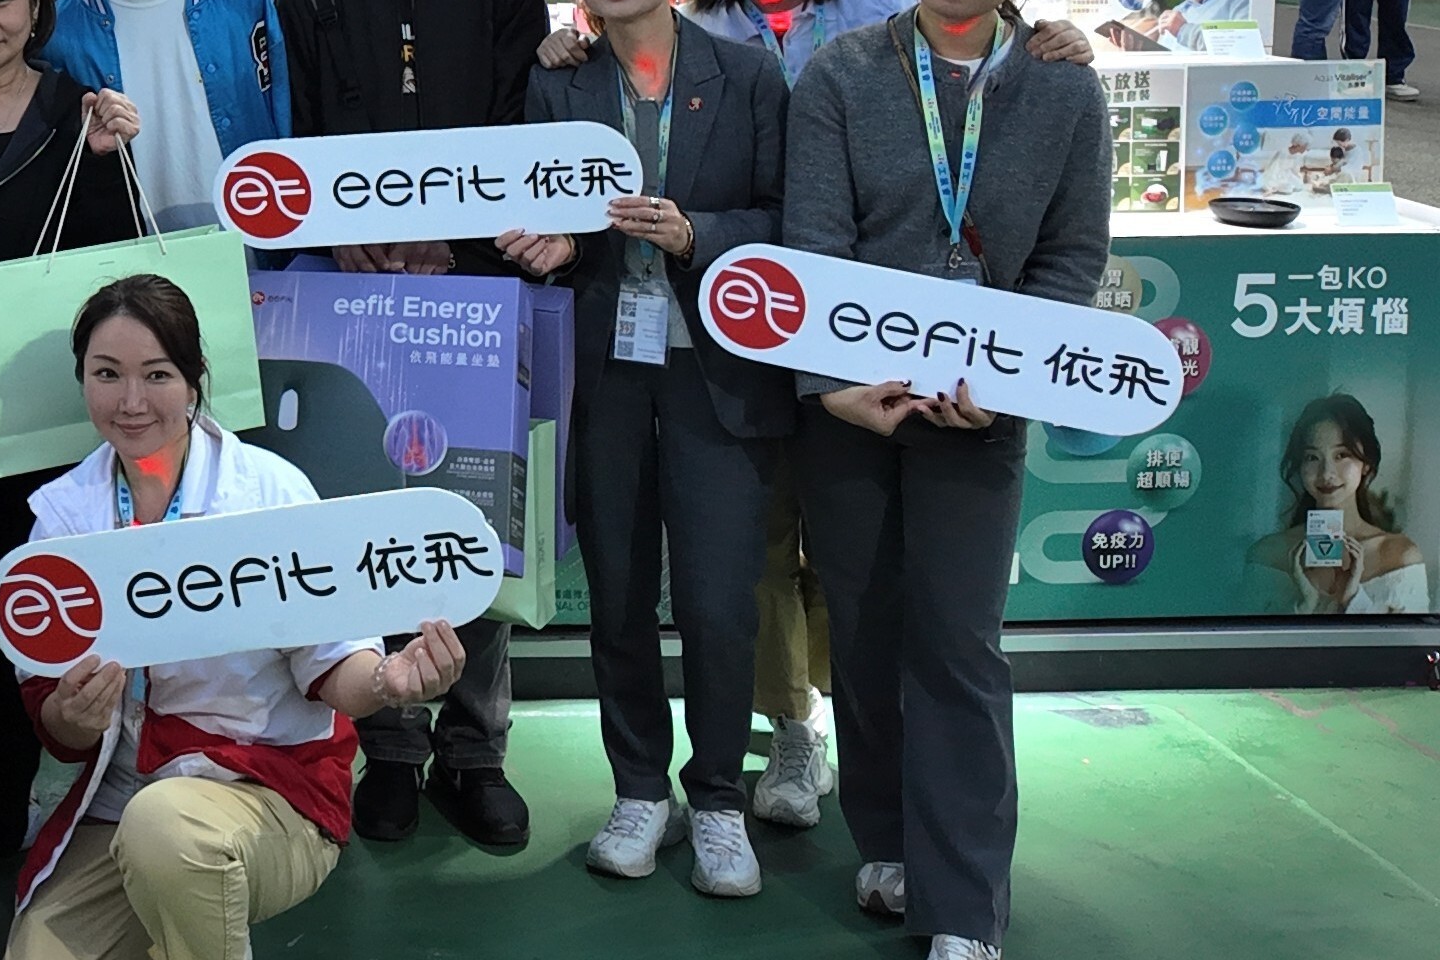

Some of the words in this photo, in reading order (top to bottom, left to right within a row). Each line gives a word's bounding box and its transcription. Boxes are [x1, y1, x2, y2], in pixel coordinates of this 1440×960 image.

[333, 164, 506, 209] eefit
[523, 158, 634, 200] 依飛
[1288, 265, 1388, 290] 一包KO
[333, 295, 395, 318] eefit
[402, 296, 503, 326] Energy
[389, 322, 502, 348] Cushion
[829, 302, 1024, 375] eefit
[1044, 344, 1171, 407] 依飛
[1146, 449, 1182, 468] 排便
[1136, 471, 1190, 489] 超順暢
[1092, 531, 1144, 550] 免疫力
[1099, 553, 1137, 570] UP!!
[126, 551, 334, 620] eefit
[357, 531, 494, 591] 依飛
